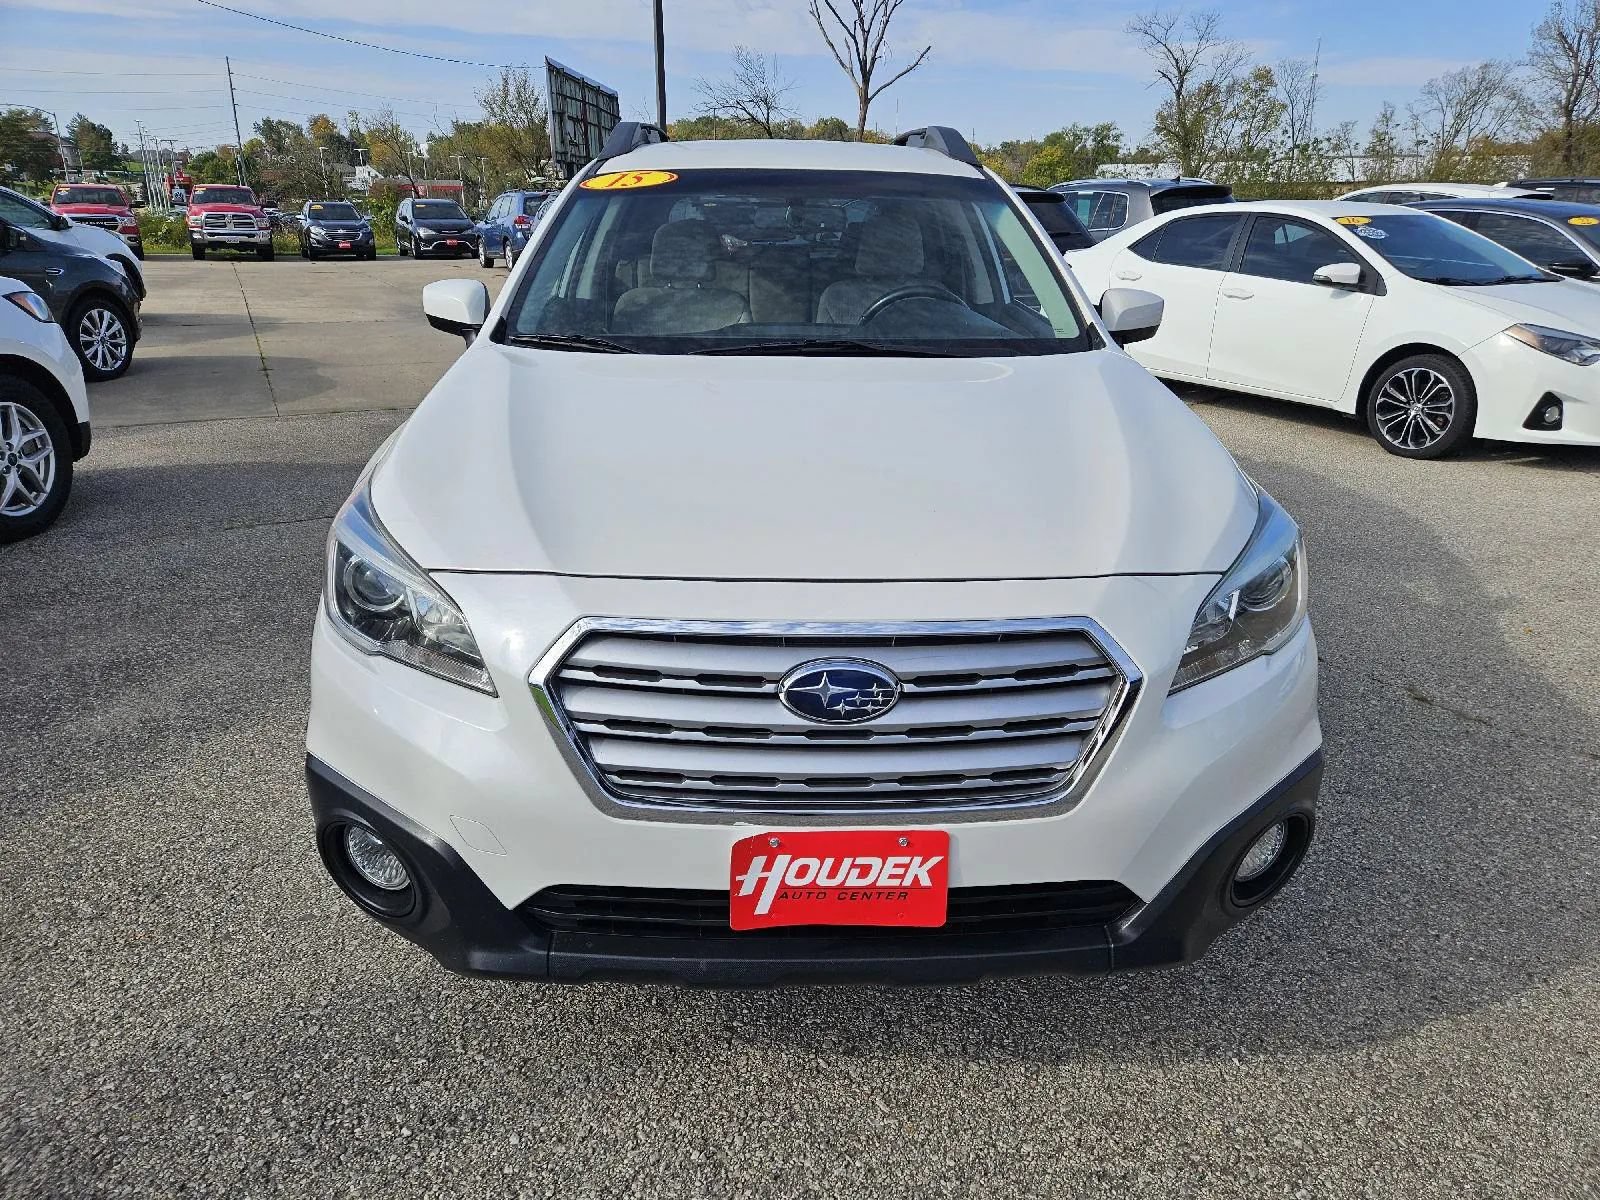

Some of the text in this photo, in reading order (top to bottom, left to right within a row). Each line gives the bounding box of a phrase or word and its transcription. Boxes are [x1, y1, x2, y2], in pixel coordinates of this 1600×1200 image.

[605, 172, 652, 187] 15
[735, 854, 944, 916] HOUDEK
[777, 891, 909, 901] AUTO CENTER
